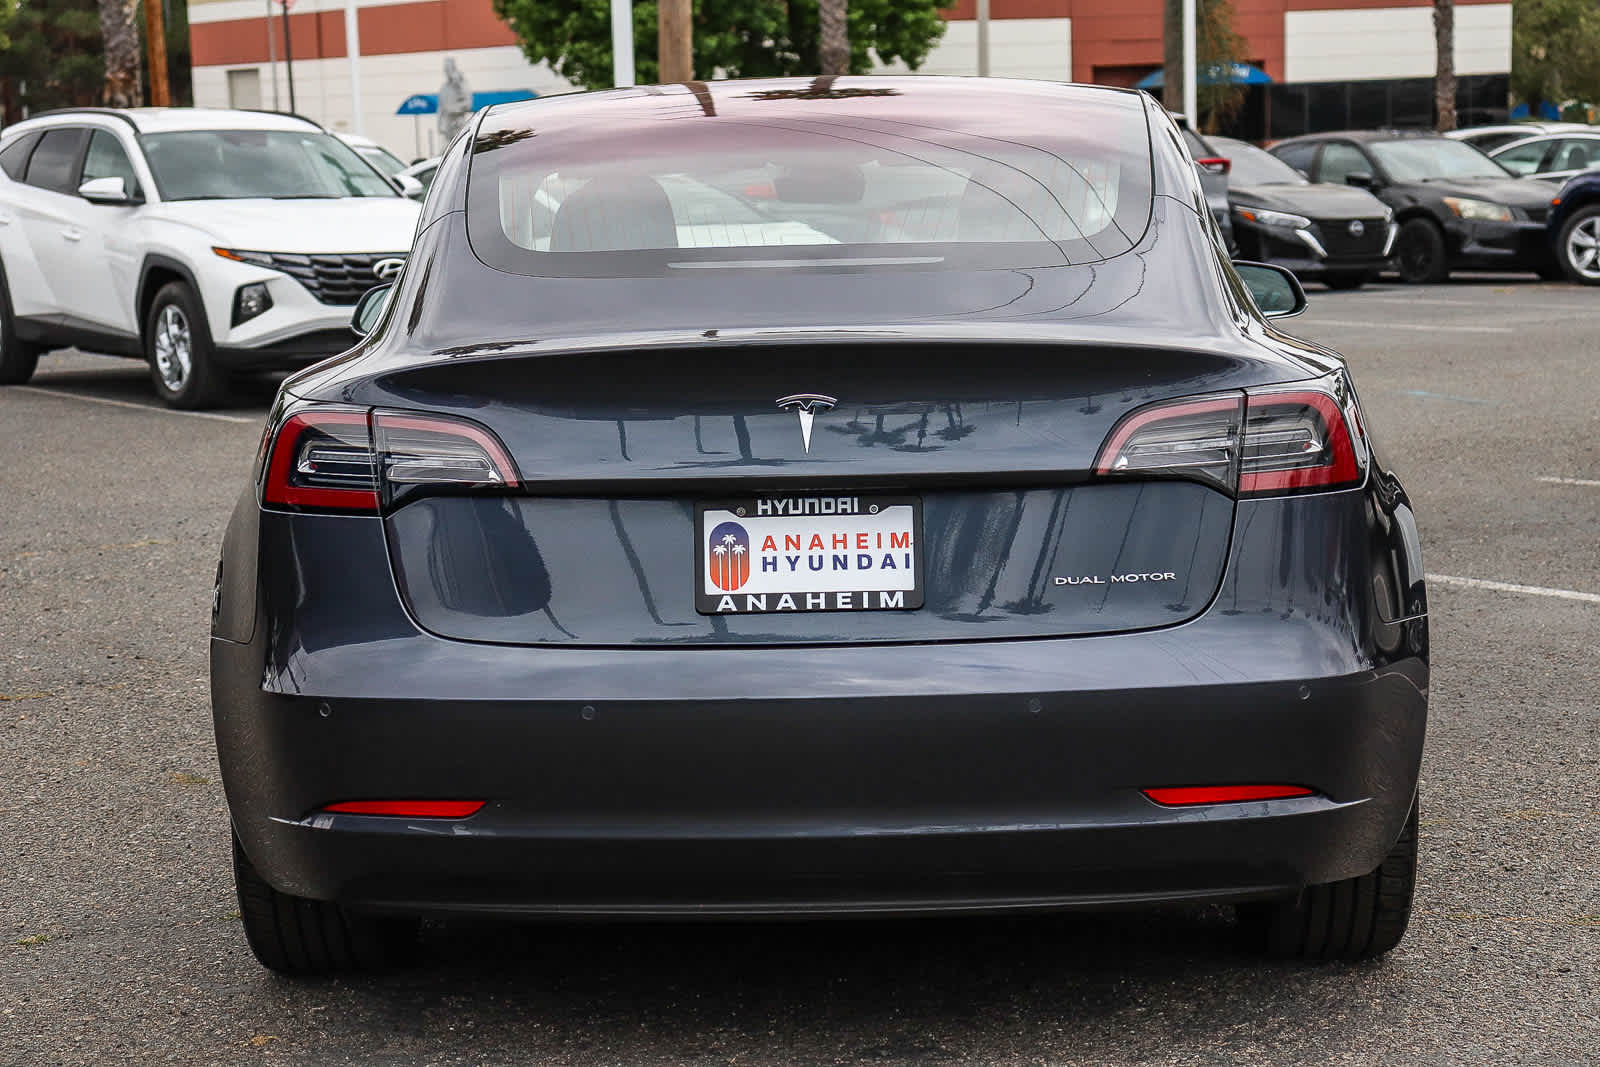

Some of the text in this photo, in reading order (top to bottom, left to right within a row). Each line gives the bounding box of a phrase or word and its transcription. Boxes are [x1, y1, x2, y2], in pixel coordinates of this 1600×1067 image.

[757, 497, 859, 515] HYUNDAI
[761, 532, 910, 552] ANAHEIM
[762, 553, 911, 572] HYUNDAI
[1055, 572, 1177, 585] DUAL MOTOR
[716, 591, 905, 612] ANAHEIM
